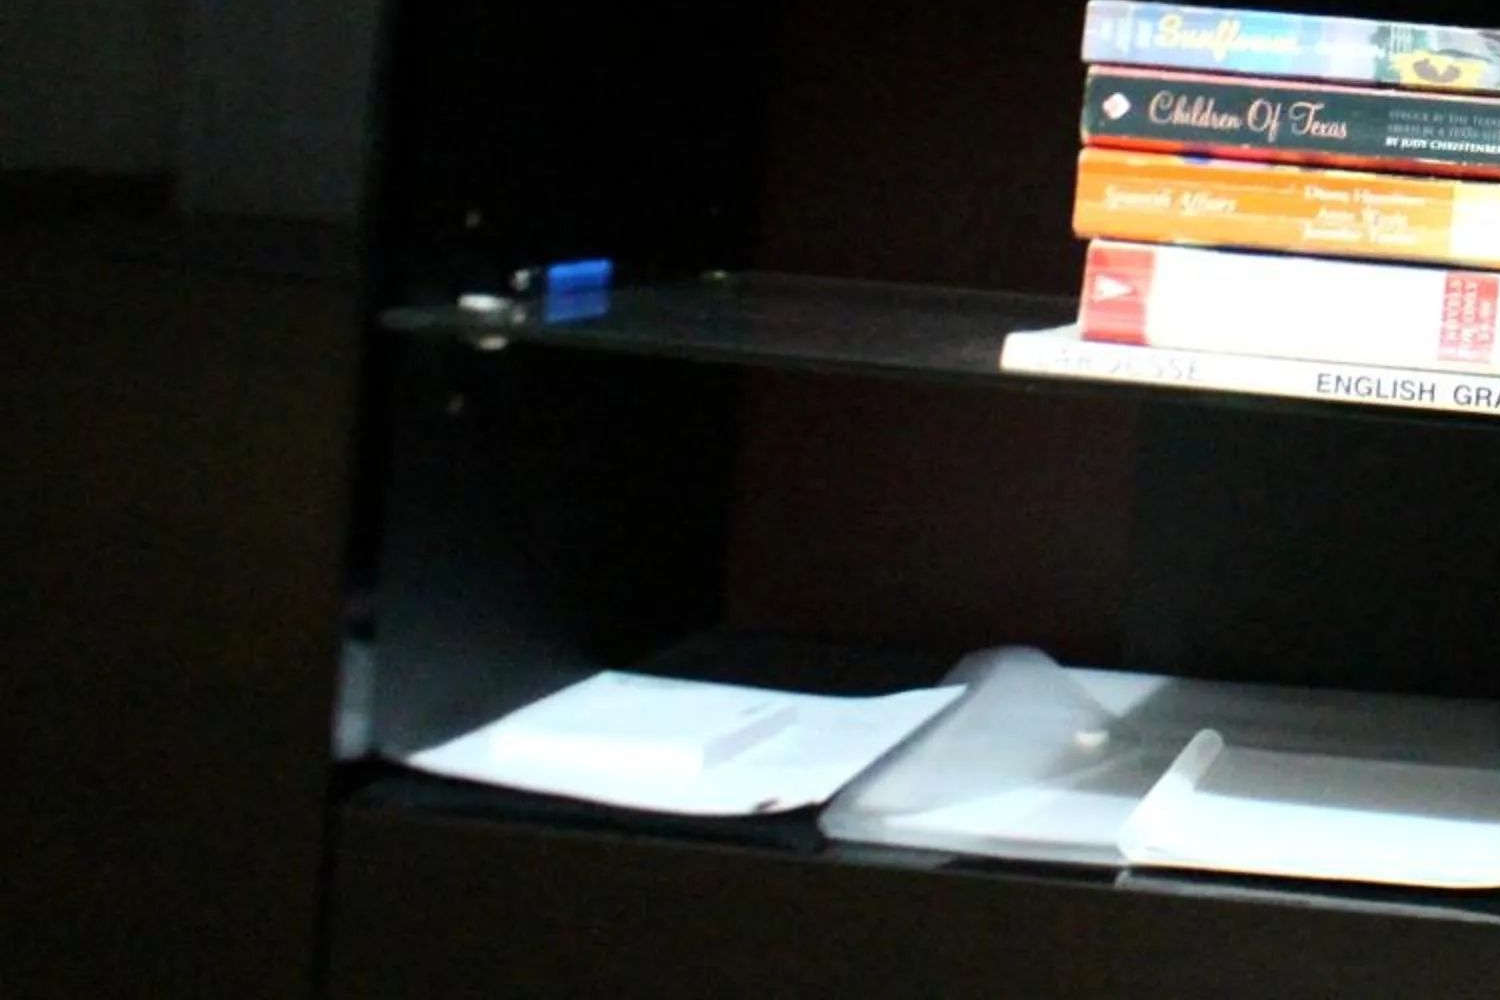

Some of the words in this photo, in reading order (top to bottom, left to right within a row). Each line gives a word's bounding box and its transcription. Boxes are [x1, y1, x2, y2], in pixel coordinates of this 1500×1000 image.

[1147, 91, 1243, 130] Children
[1246, 98, 1283, 142] Of
[1289, 101, 1350, 140] Texas
[1385, 137, 1398, 147] BY
[1400, 137, 1427, 150] JUDY
[1314, 373, 1437, 405] ENGLISH
